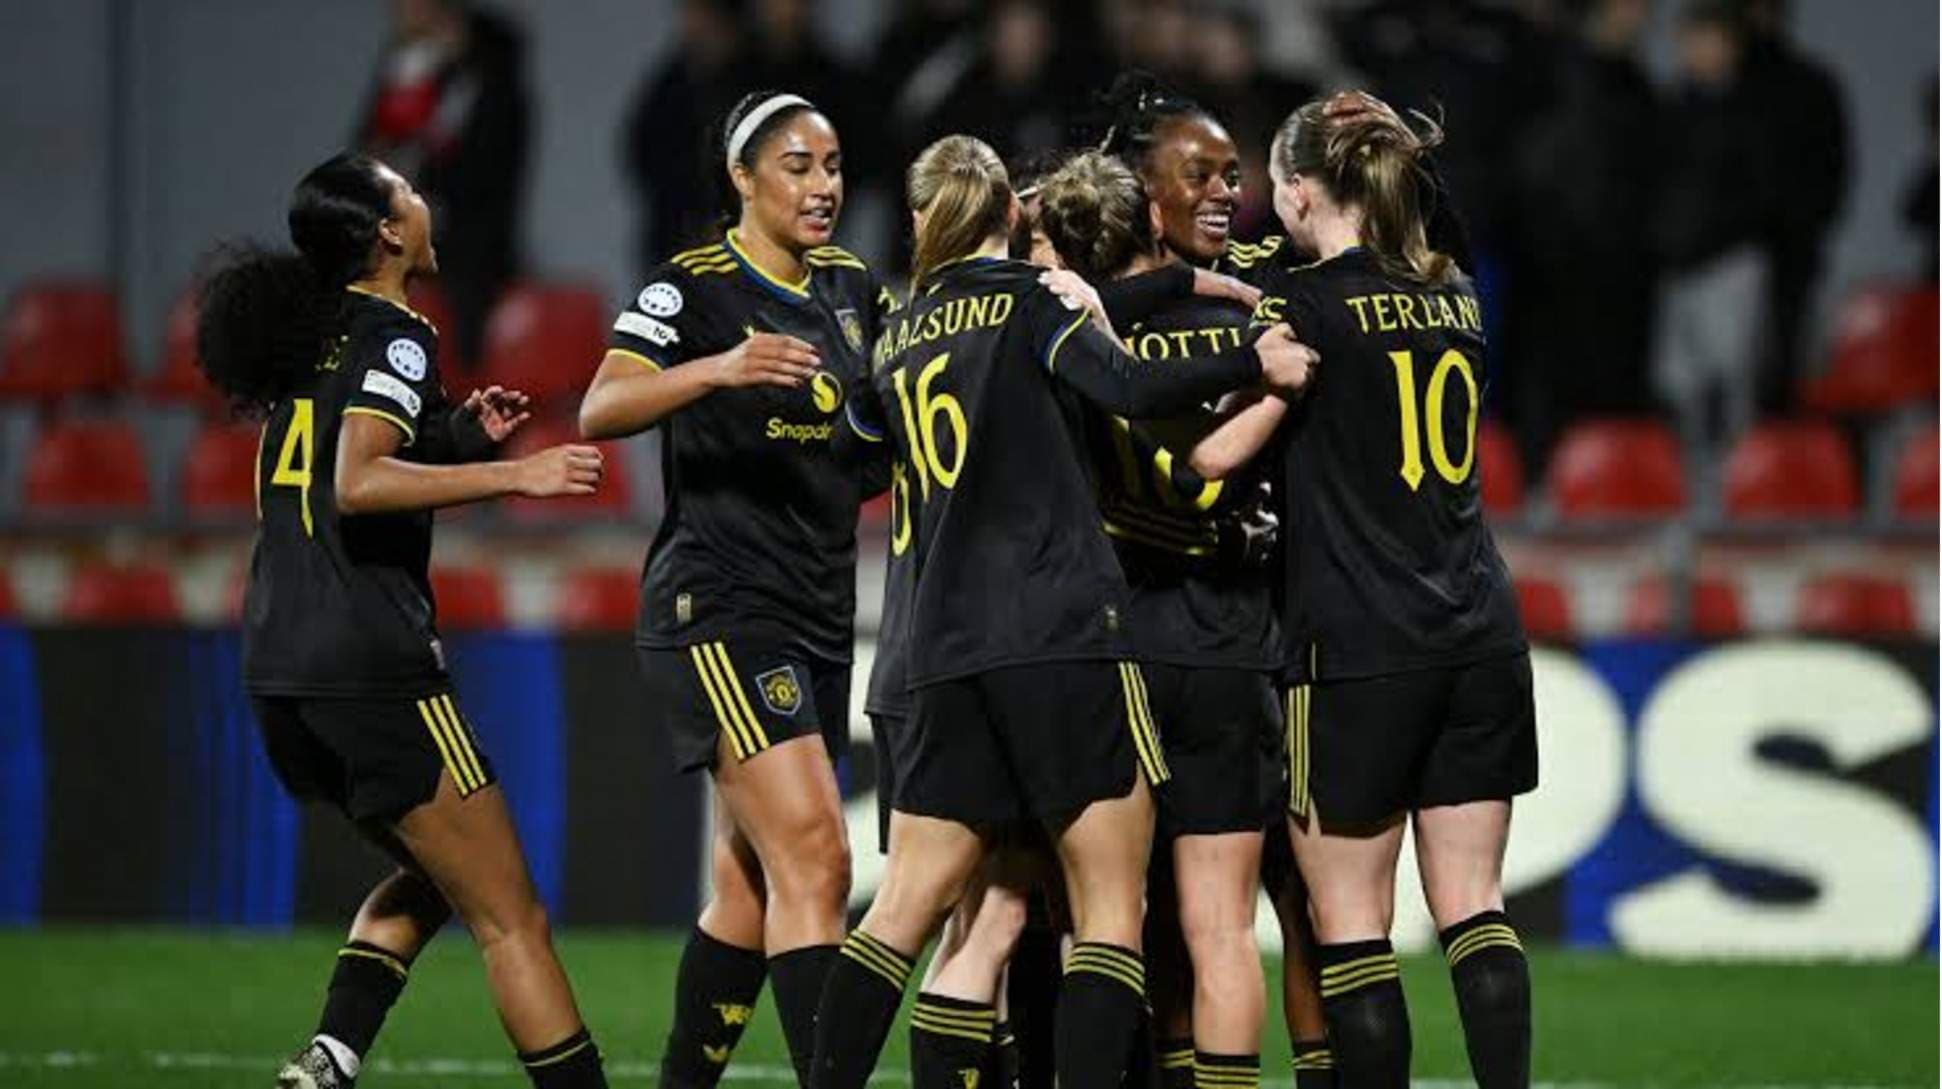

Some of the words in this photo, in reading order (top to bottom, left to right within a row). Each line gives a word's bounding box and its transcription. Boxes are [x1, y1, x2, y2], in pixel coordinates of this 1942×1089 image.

[1346, 293, 1482, 333] TERLAN
[255, 398, 314, 538] 4
[765, 417, 835, 445] Snapdr
[892, 353, 968, 502] 16
[1387, 349, 1479, 492] 10
